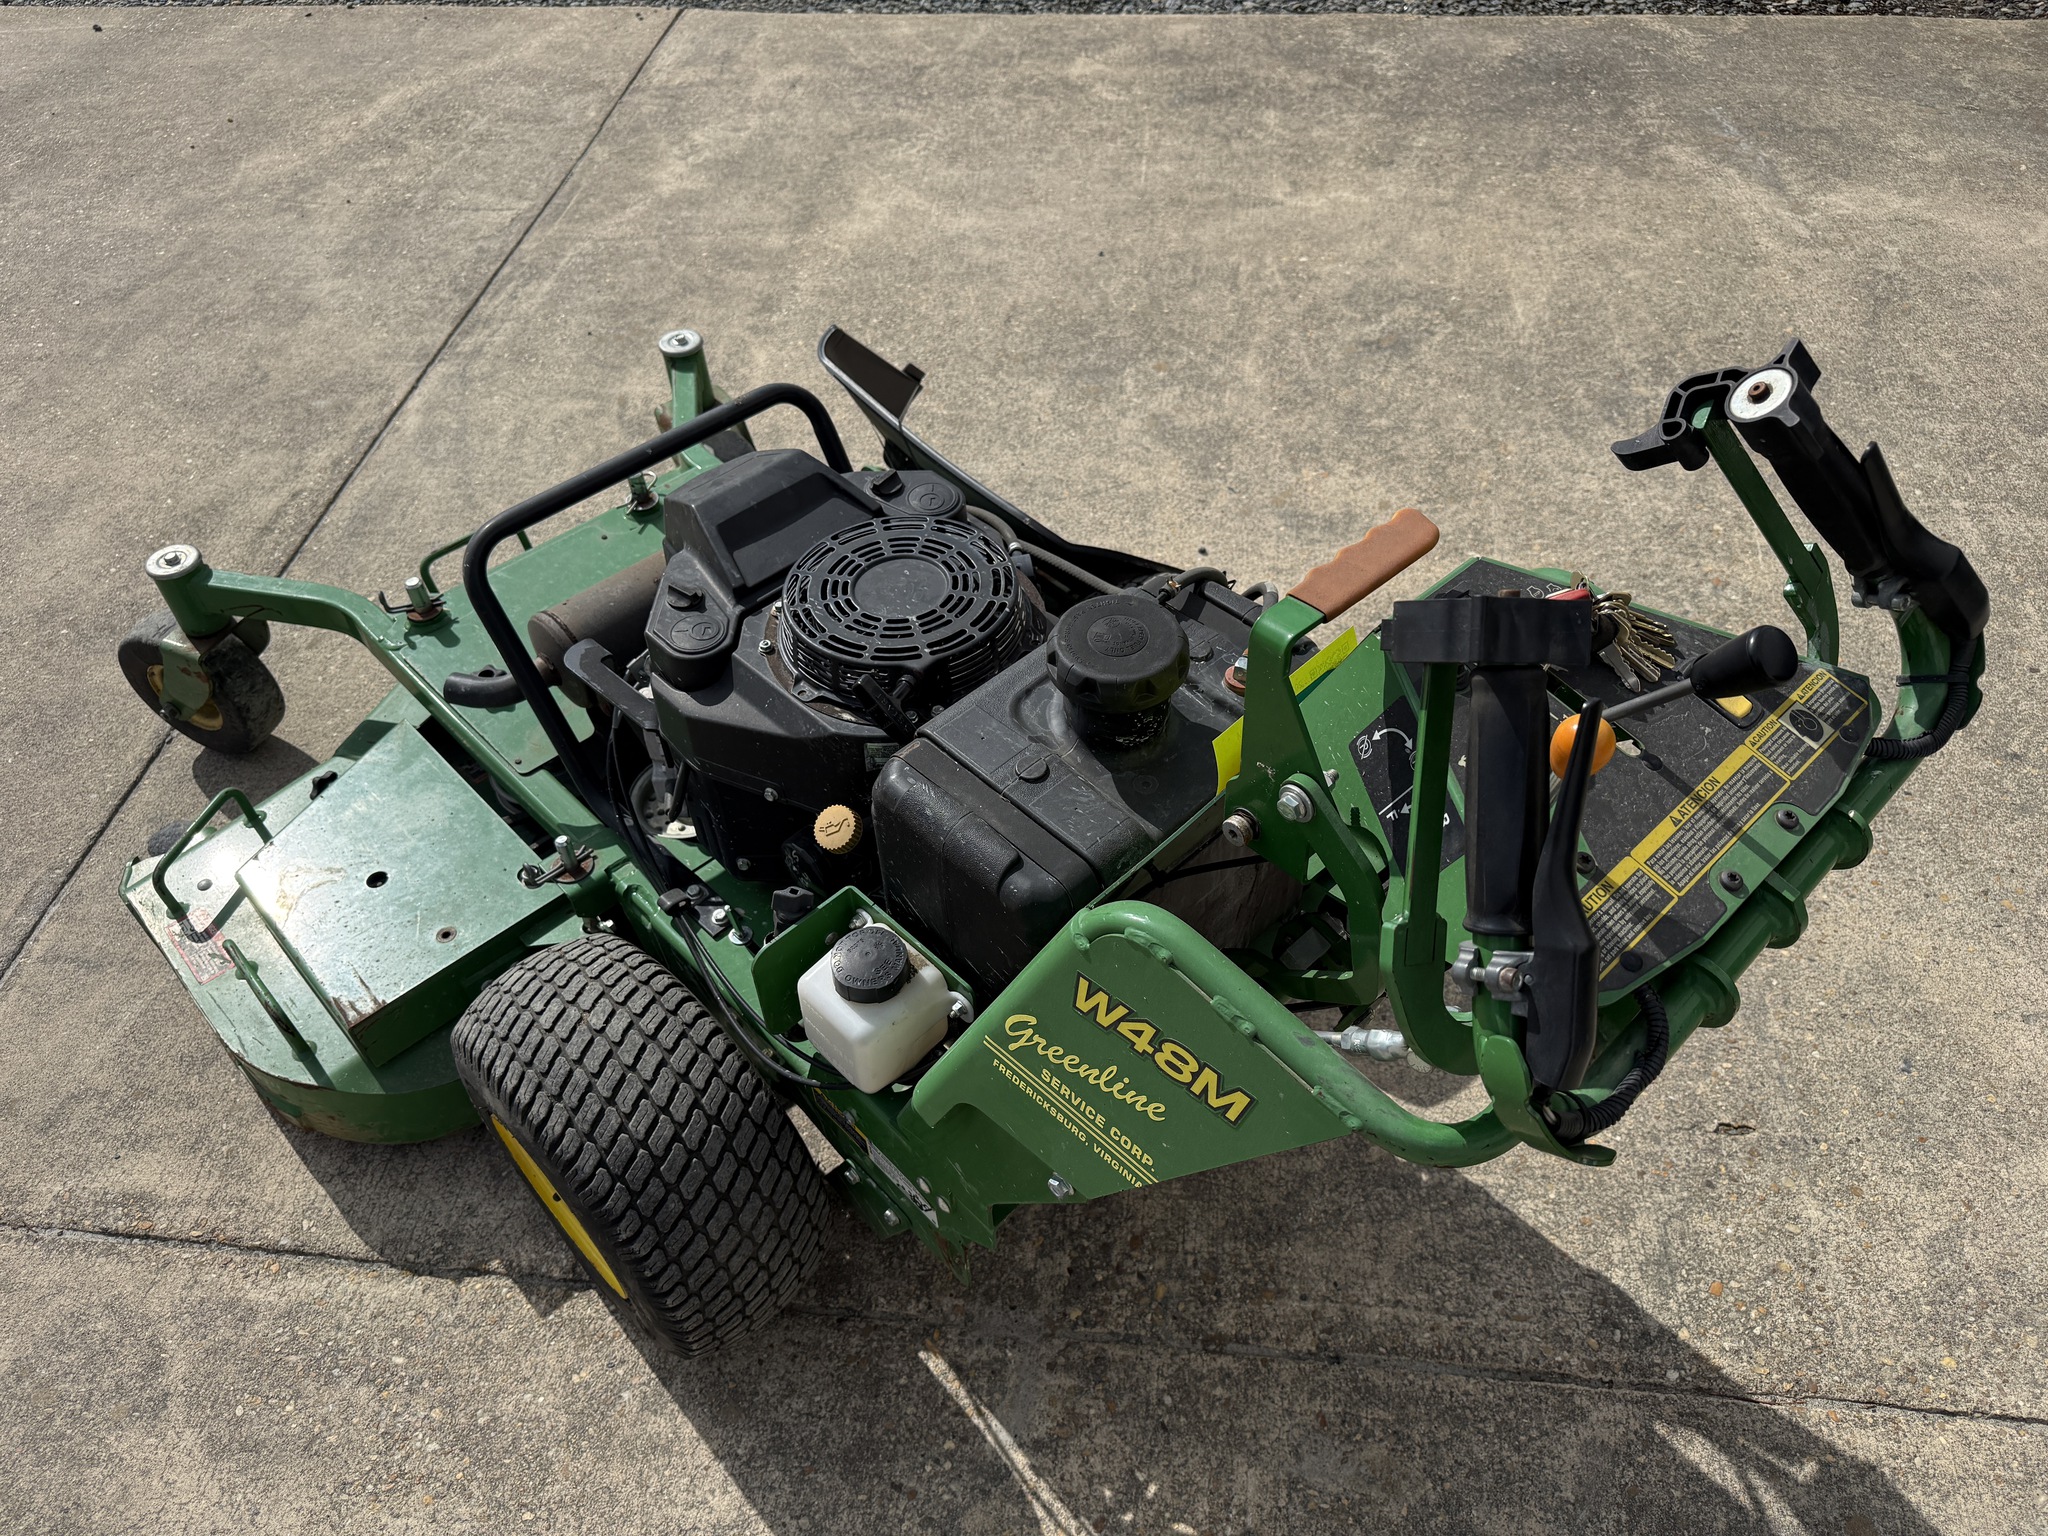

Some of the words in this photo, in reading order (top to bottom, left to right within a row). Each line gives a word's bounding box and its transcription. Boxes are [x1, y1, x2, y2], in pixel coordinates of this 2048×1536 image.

[1802, 670, 1828, 698] ATENCION
[1752, 719, 1778, 741] CAUTION
[1678, 776, 1721, 820] ATENCION
[1004, 1014, 1166, 1122] Greenline
[1075, 976, 1252, 1123] W48M
[992, 1058, 1089, 1146] FREDERICKSBURG,
[1040, 1068, 1106, 1128] SERVICE
[1109, 1126, 1155, 1172] CORP.
